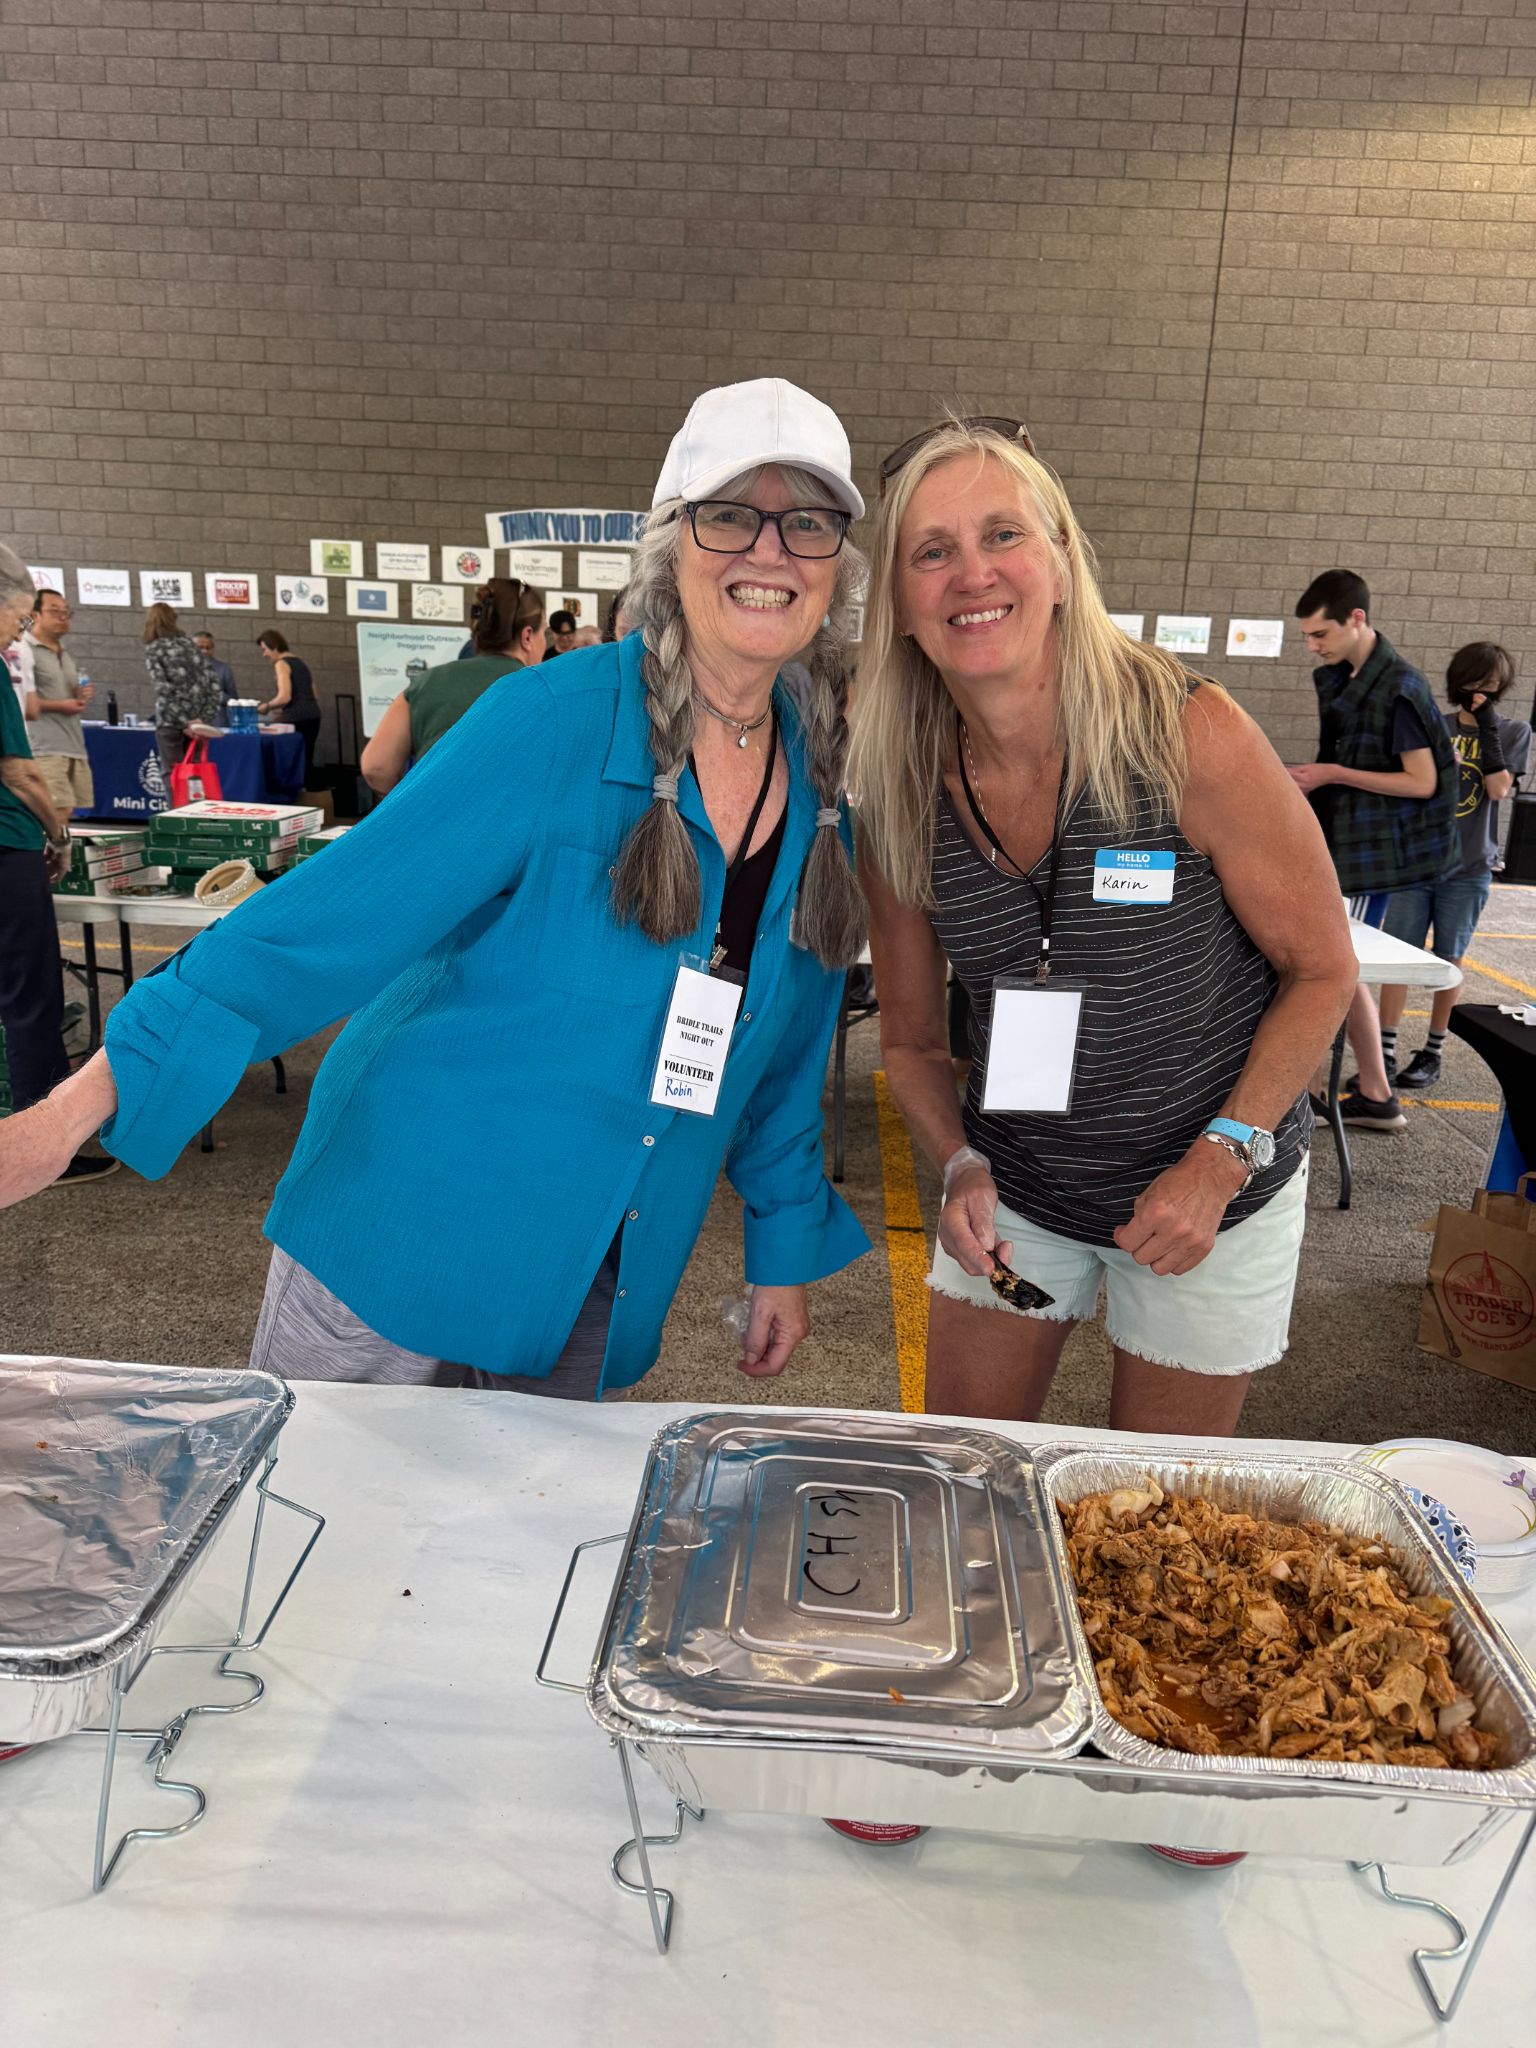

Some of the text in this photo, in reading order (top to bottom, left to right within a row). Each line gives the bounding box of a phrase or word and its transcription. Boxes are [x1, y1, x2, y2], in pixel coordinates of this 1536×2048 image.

[498, 511, 550, 544] THANK
[549, 512, 581, 543] YOU
[582, 514, 601, 543] TO
[603, 512, 634, 542] OUR
[367, 632, 463, 643] Neighborhood Outreach
[396, 643, 436, 651] Programs
[113, 796, 168, 811] Mini Cit
[1117, 853, 1150, 862] HELLO
[1102, 874, 1149, 890] Karin
[677, 1016, 723, 1036] BRIDLE TRAILS
[680, 1031, 714, 1047] NIGHT OUT
[664, 1060, 714, 1081] VOLUNTEER
[665, 1078, 692, 1096] Robin
[1453, 1292, 1524, 1313] TRADER
[1463, 1308, 1517, 1327] JOE'S
